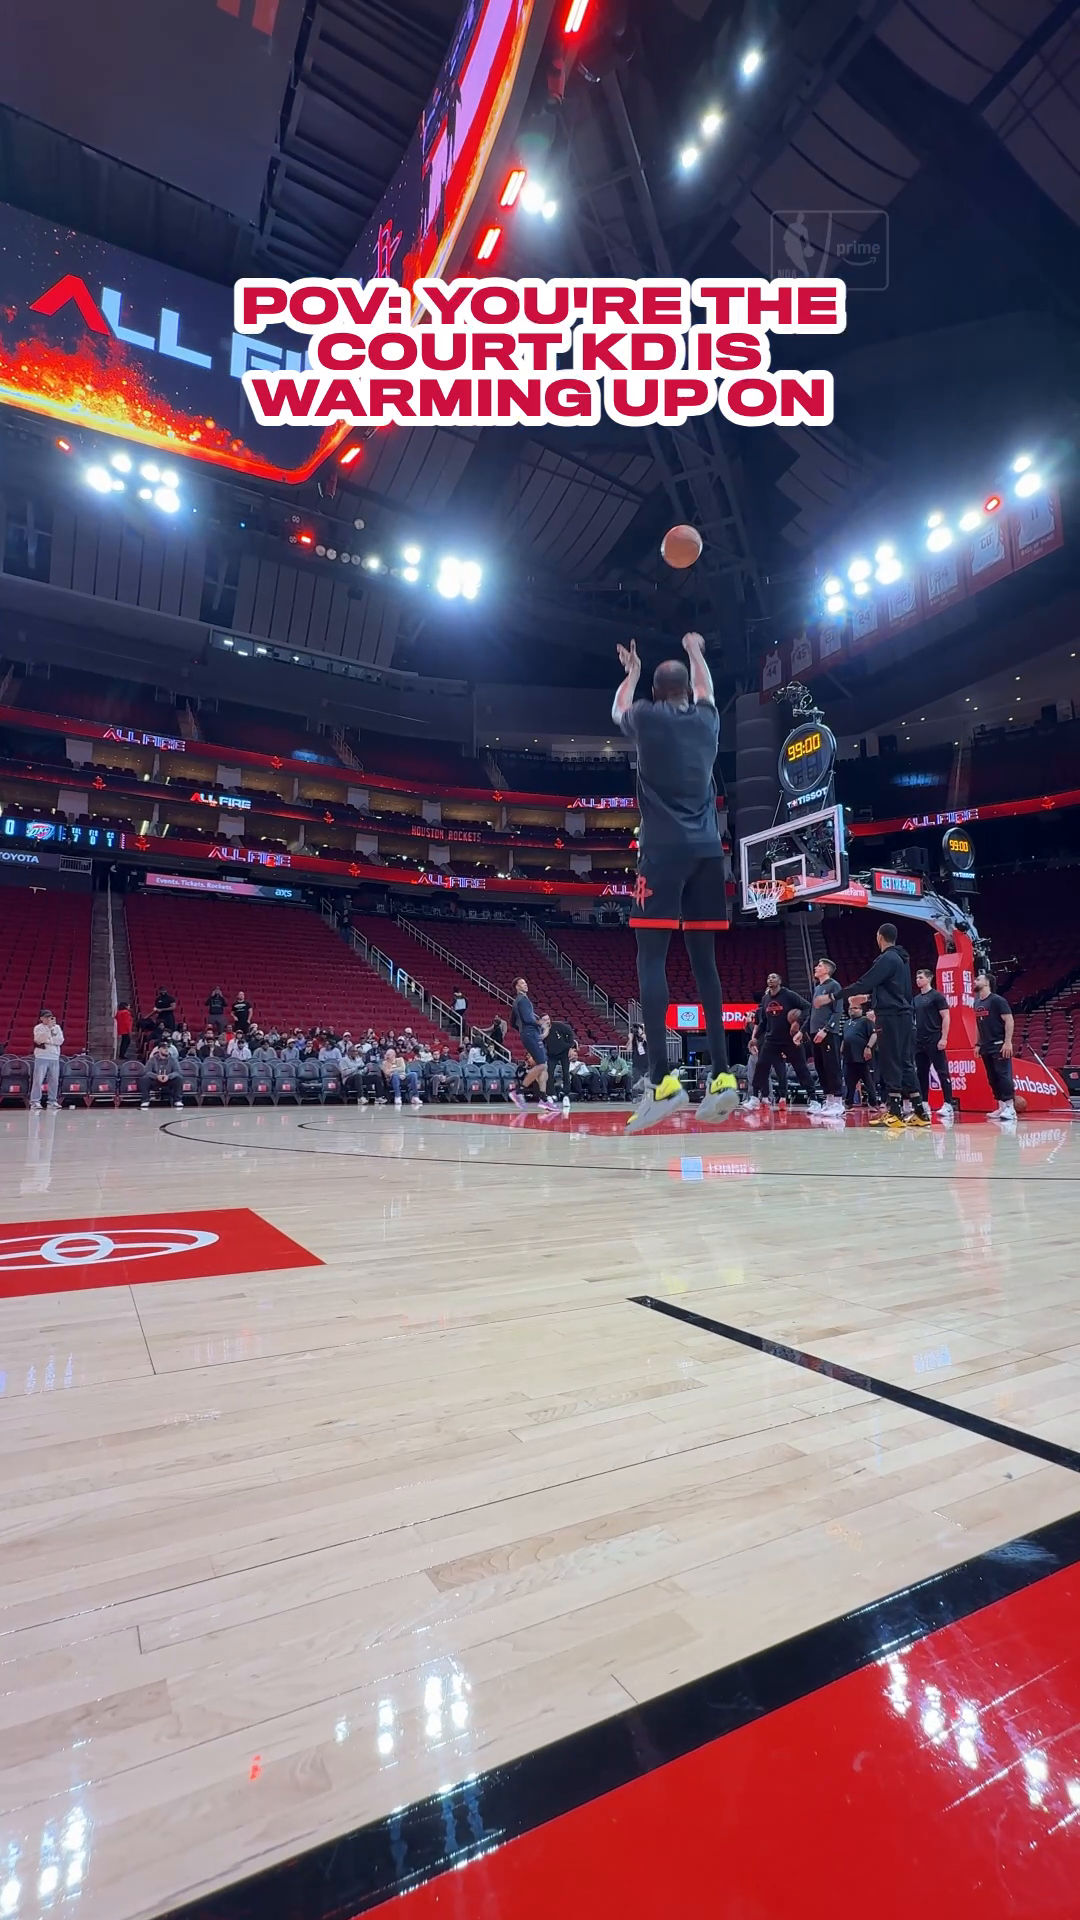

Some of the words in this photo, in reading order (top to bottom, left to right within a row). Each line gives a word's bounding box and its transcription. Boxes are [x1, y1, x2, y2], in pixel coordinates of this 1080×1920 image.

[30, 274, 211, 369] ALL
[103, 728, 140, 743] ALL
[143, 734, 186, 752] FIRE
[787, 733, 820, 761] 99:00
[191, 792, 218, 804] ALL
[219, 796, 251, 809] FIRE
[902, 818, 936, 830] ALL
[411, 825, 444, 839] HOUSTON
[448, 830, 482, 842] ROCKETS
[949, 839, 969, 852] 99:00
[0, 851, 40, 863] TOYOTA
[208, 846, 246, 862] ALL
[248, 851, 291, 867] FIRE
[449, 876, 486, 889] FIRE
[602, 884, 633, 896] ALL
[942, 970, 954, 982] GET
[942, 982, 955, 994] THE
[948, 1060, 976, 1076] eague
[951, 1076, 967, 1090] ass
[1013, 1075, 1058, 1096] inbase
